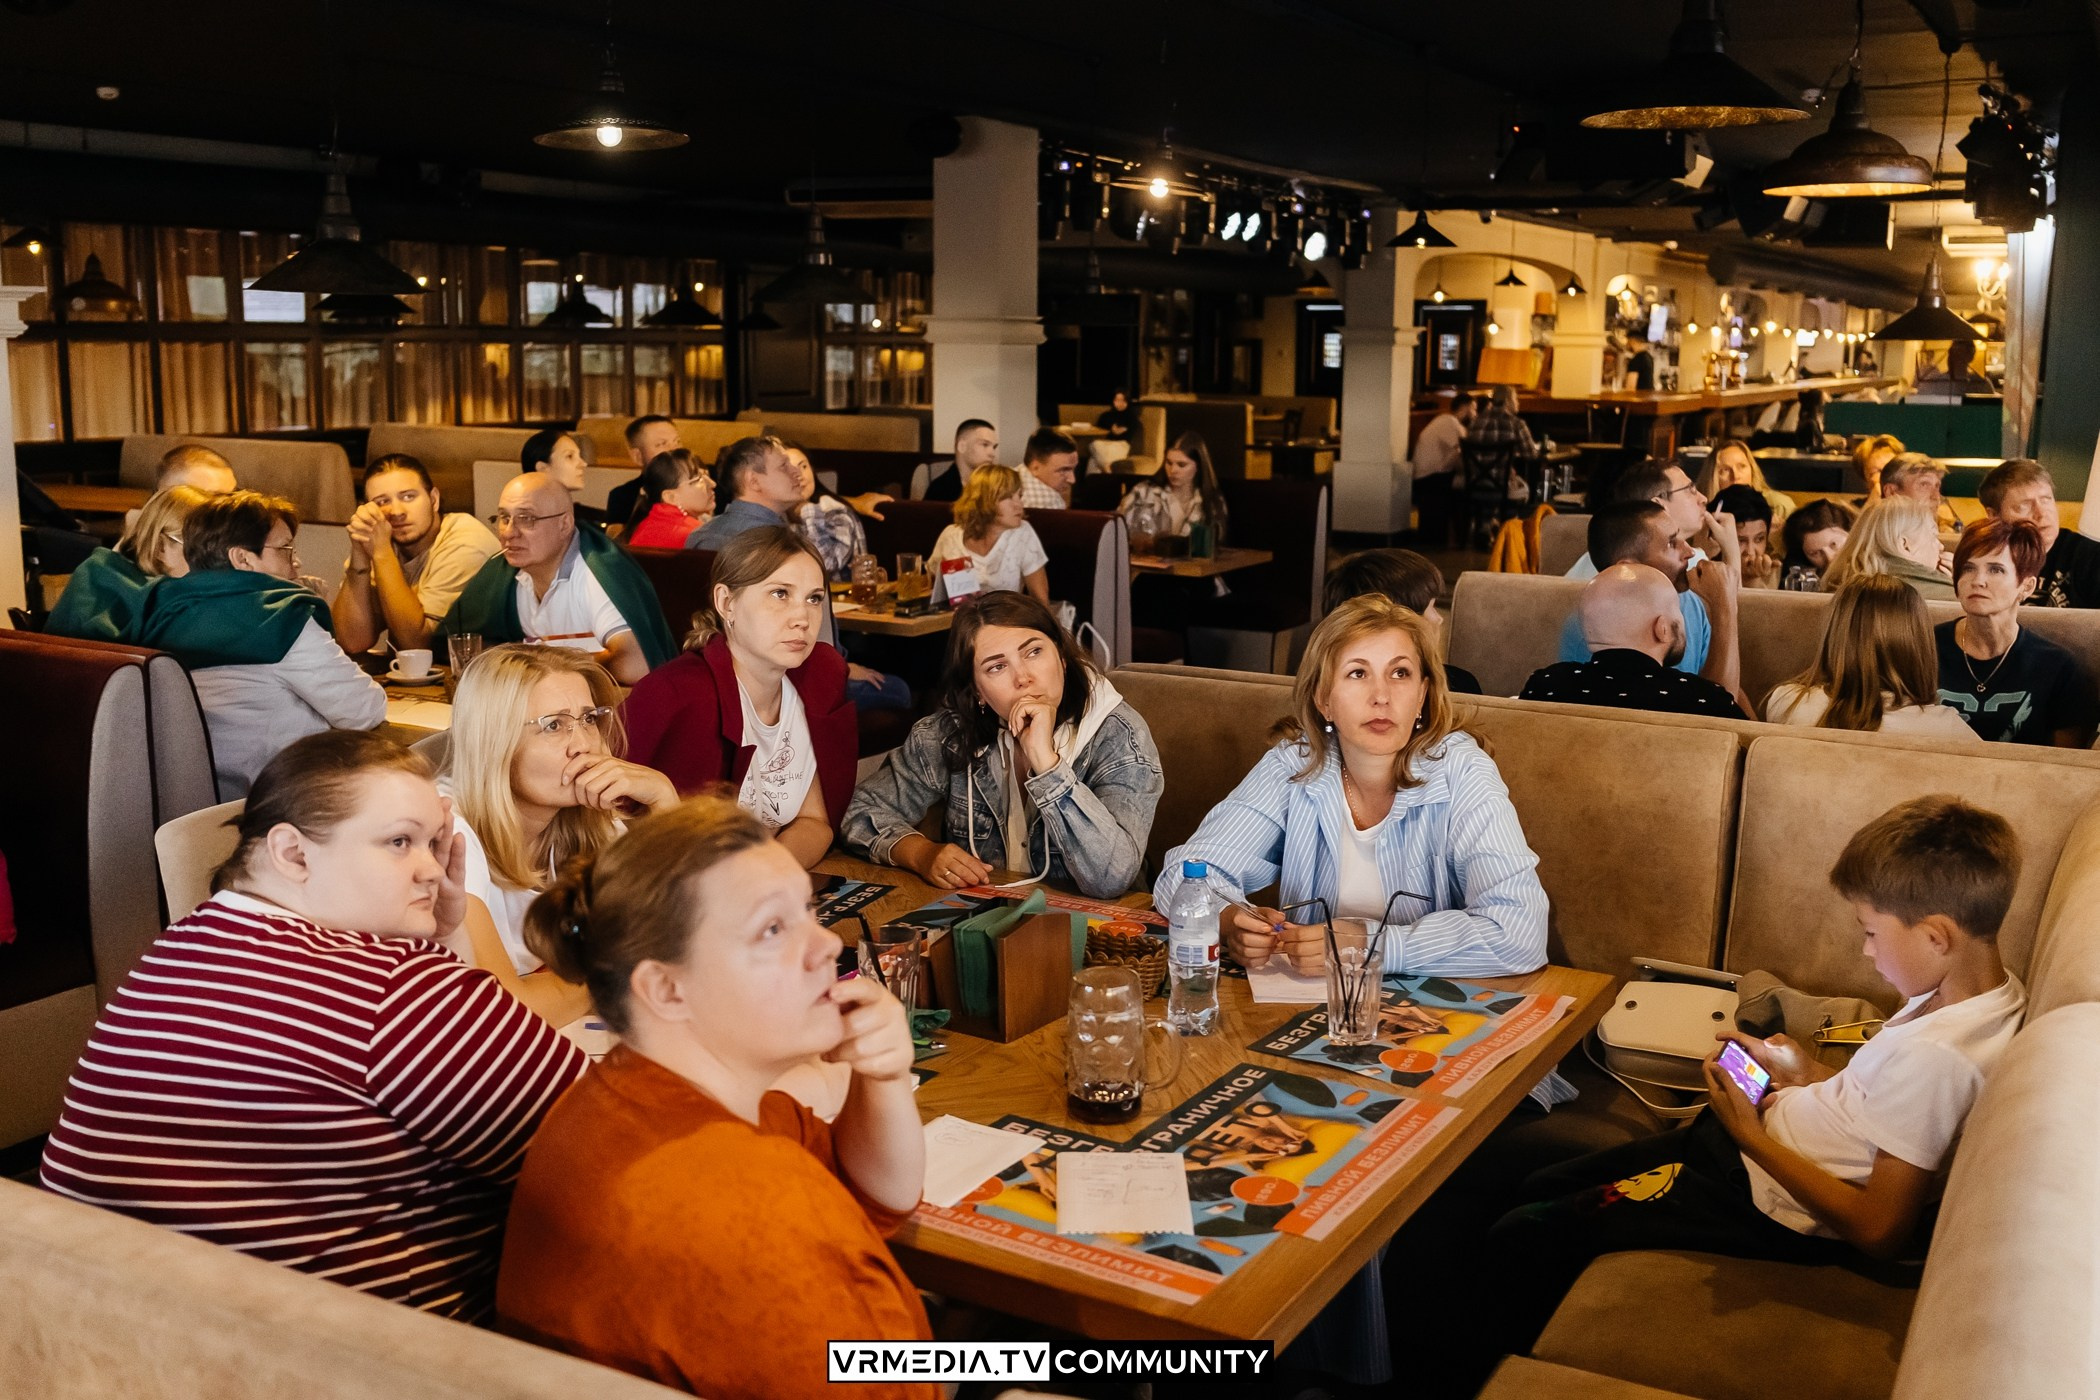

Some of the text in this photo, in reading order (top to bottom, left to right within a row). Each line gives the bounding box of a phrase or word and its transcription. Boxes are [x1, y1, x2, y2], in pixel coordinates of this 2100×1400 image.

[1439, 1044, 1488, 1083] ПИВНОЙ
[1489, 1008, 1546, 1048] БЕЗЛИМИТ
[1300, 1169, 1363, 1220] ПИВНОЙ
[1357, 1114, 1429, 1170] БЕЗЛИМИТ
[1017, 1231, 1174, 1282] БЕЗЛИМИТ
